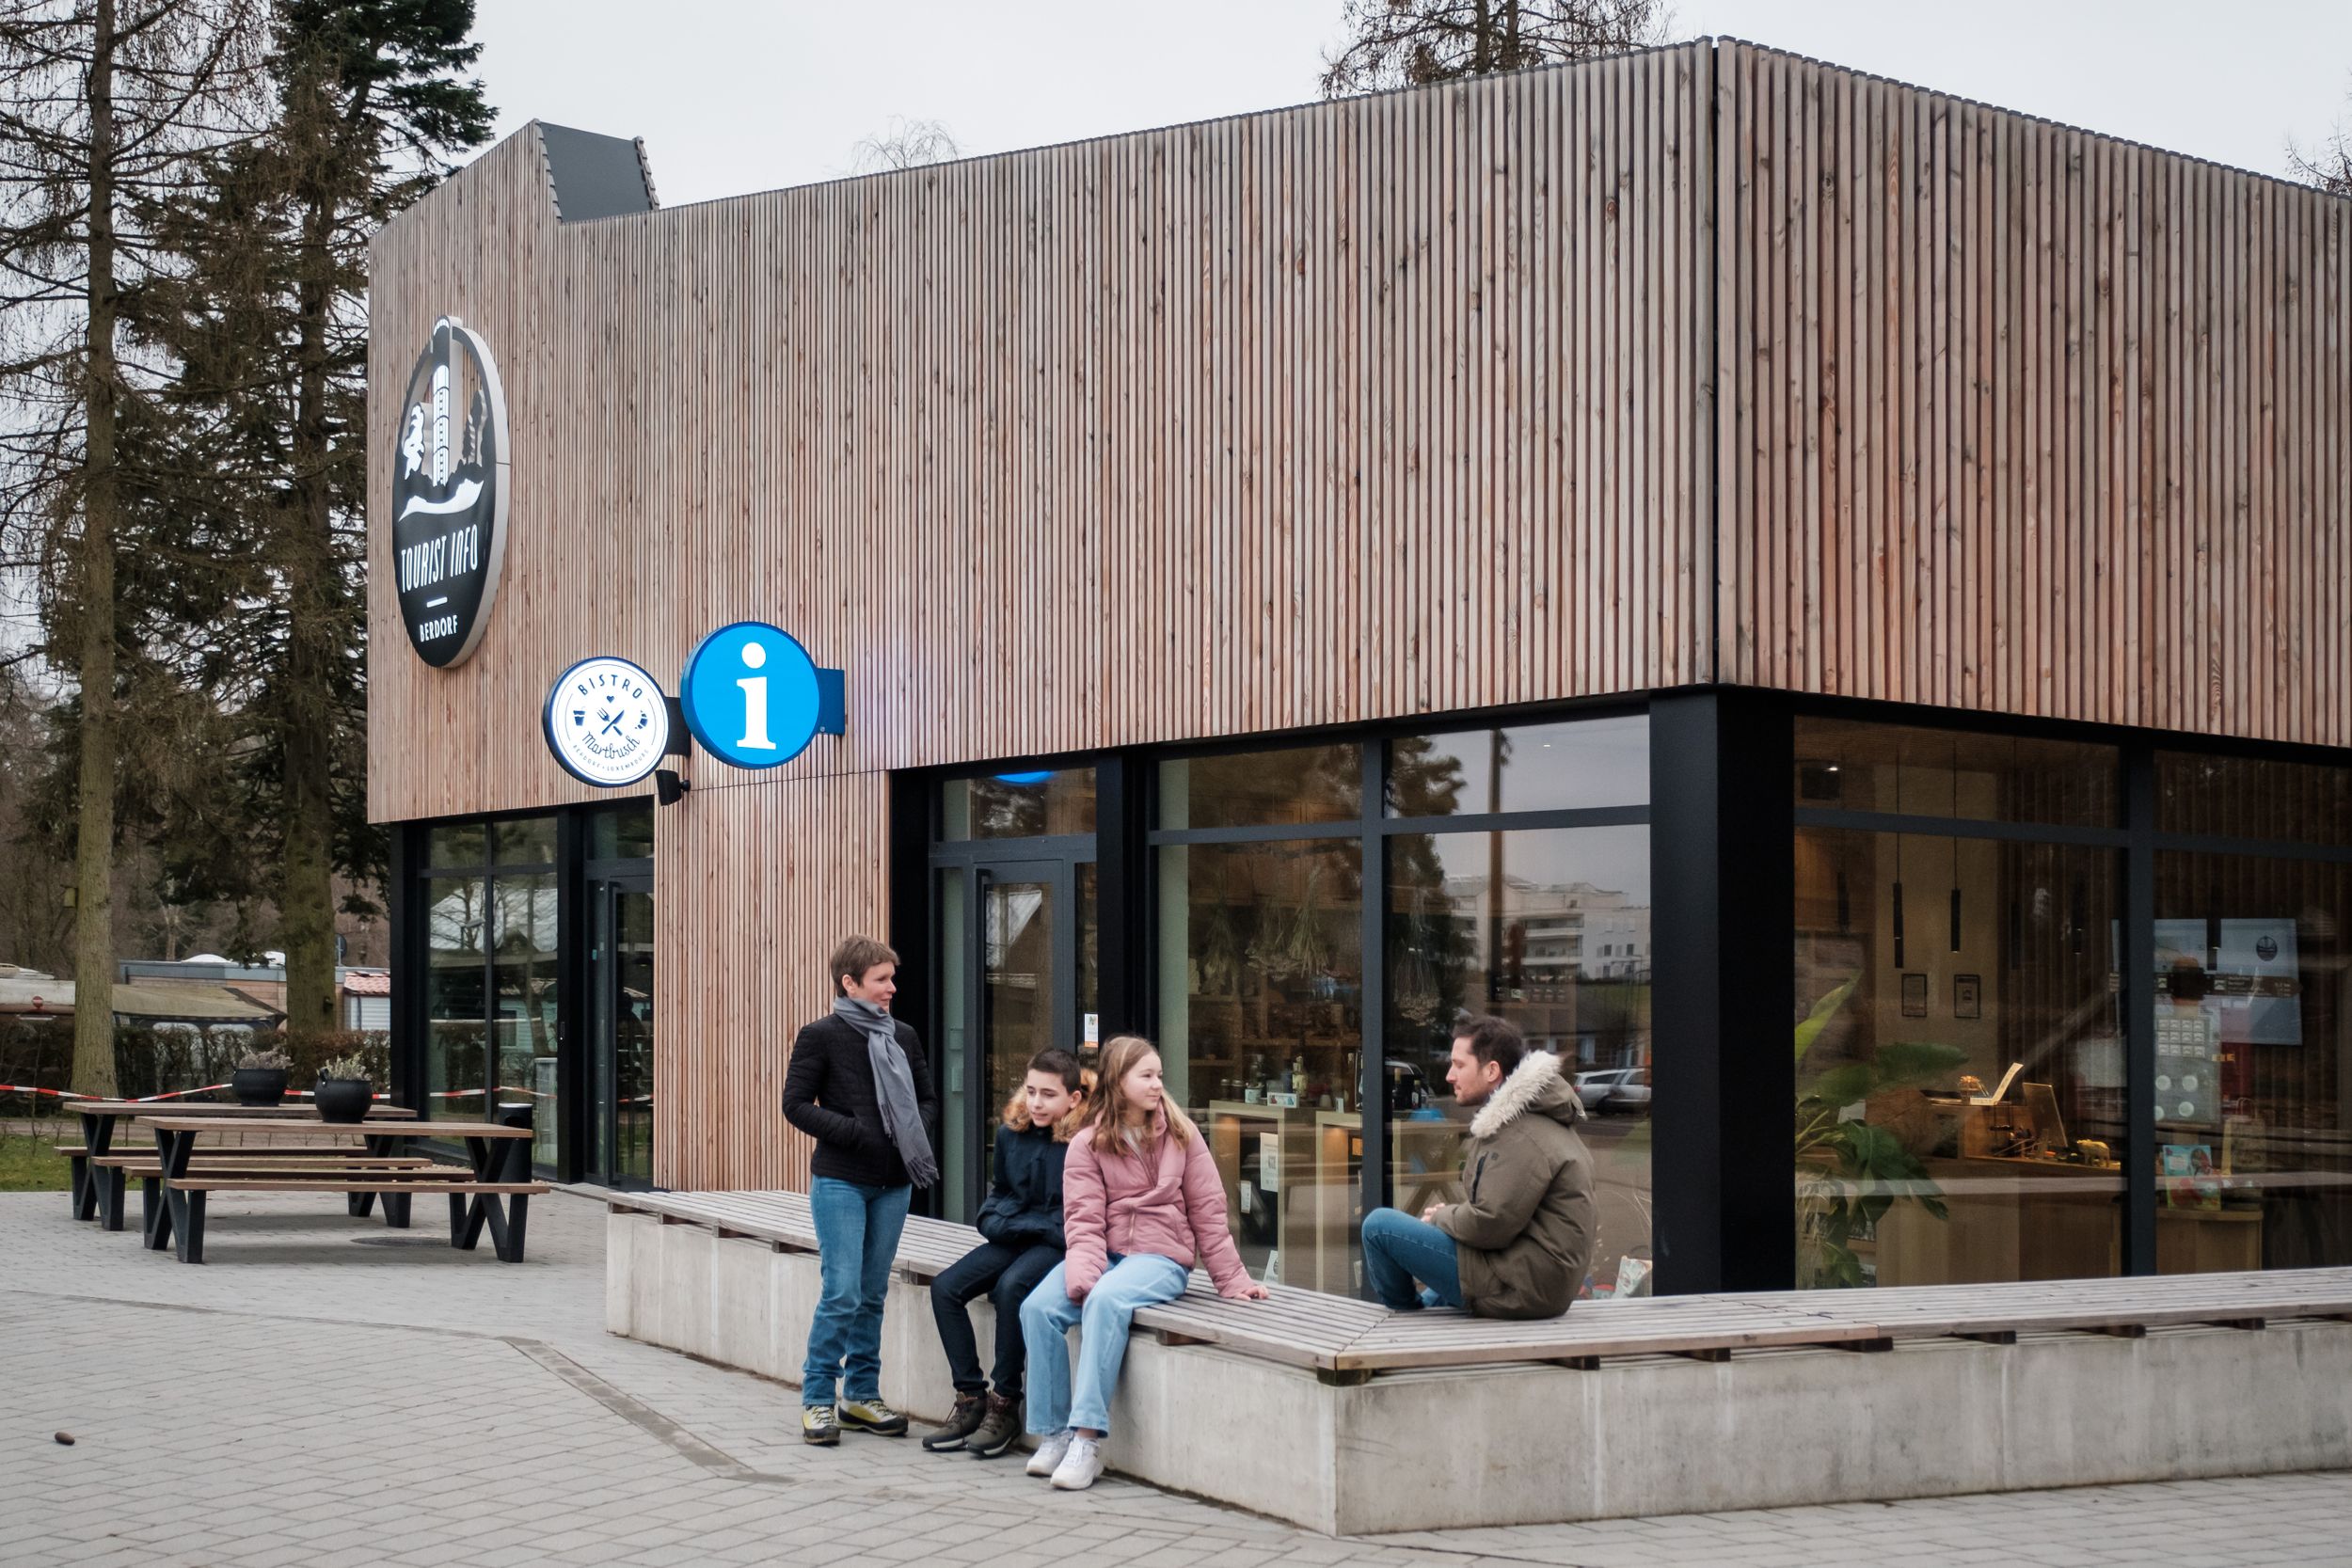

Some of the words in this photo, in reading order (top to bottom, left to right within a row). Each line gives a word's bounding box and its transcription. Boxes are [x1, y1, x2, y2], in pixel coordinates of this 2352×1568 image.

[401, 535, 447, 594] TOURIST
[450, 524, 478, 578] INFO
[419, 614, 458, 642] BERDORF
[577, 673, 643, 700] BISTRO
[737, 641, 777, 751] i
[581, 730, 641, 760] Martbusch
